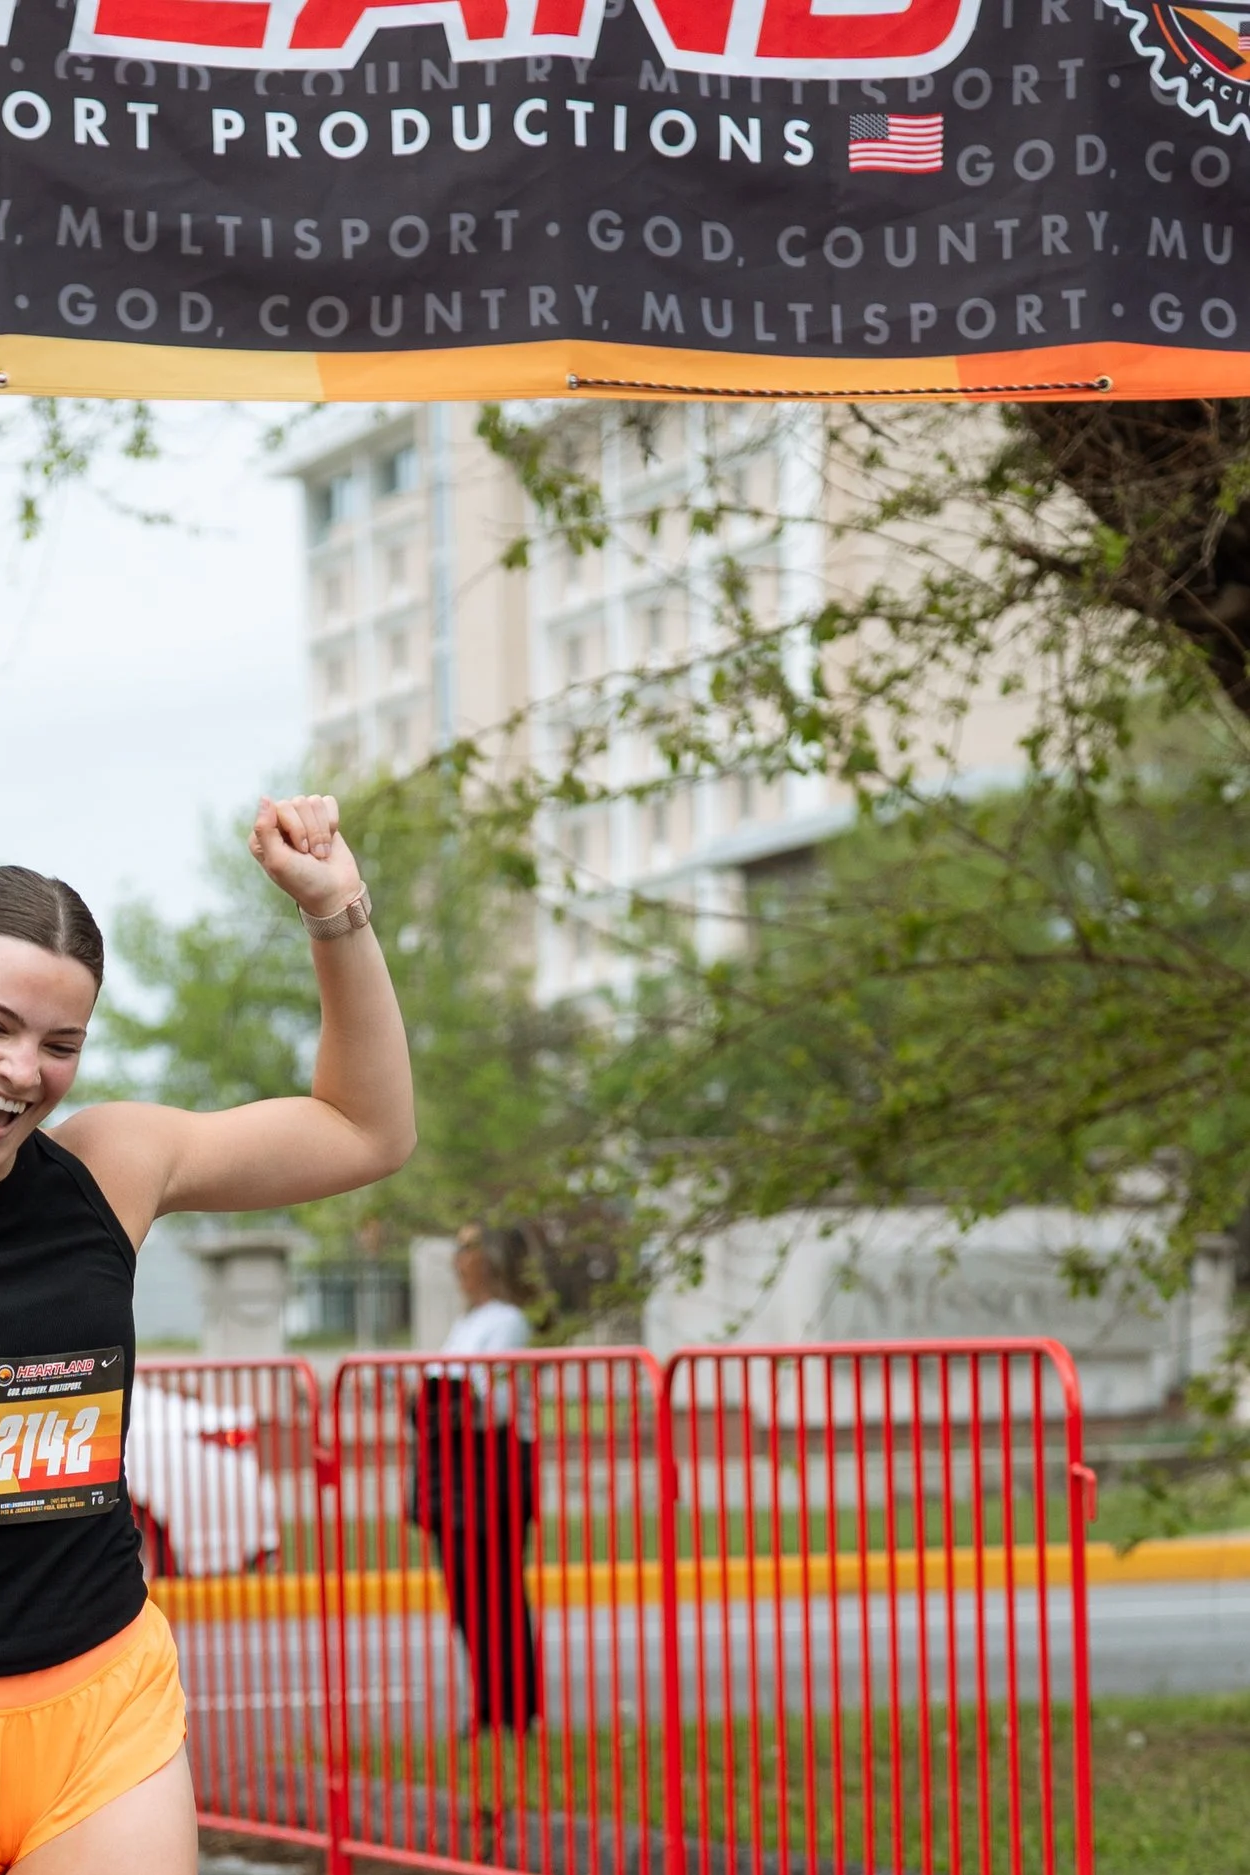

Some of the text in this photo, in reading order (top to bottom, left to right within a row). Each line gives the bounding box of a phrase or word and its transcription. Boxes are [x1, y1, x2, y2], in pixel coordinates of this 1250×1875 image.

[1189, 62, 1250, 106] RACI
[211, 97, 815, 166] PRODUCTIONS
[956, 134, 1116, 187] GOD,
[57, 204, 520, 260] MULTISPORT
[587, 209, 745, 267] GOD,
[776, 211, 1119, 269] COUNTRY,
[1147, 216, 1234, 266] MU
[58, 284, 225, 338] GOD,
[259, 284, 611, 338] COUNTRY,
[641, 288, 1087, 345] MULTISPORT
[1149, 292, 1237, 339] GO
[16, 1358, 95, 1379] HEARTLAND
